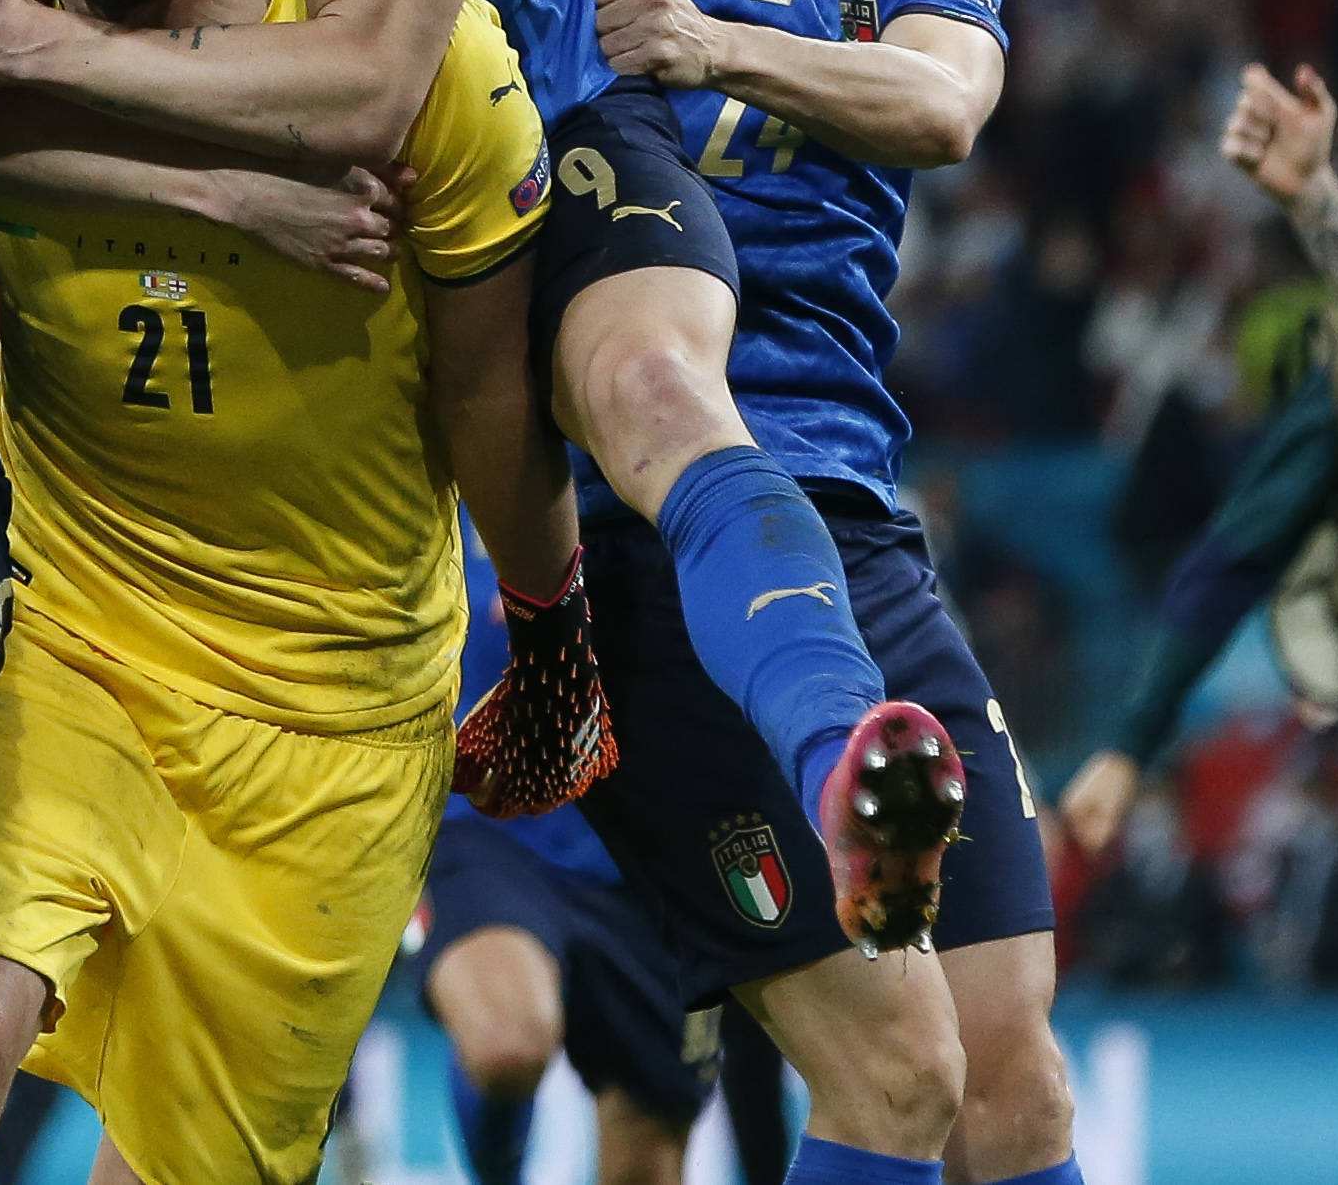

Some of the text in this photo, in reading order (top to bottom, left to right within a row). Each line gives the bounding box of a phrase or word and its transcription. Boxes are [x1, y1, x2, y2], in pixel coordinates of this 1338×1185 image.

[558, 147, 615, 210] 9
[76, 235, 240, 265] ITALIA
[118, 304, 214, 414] 21
[718, 834, 768, 865] ITALIA
